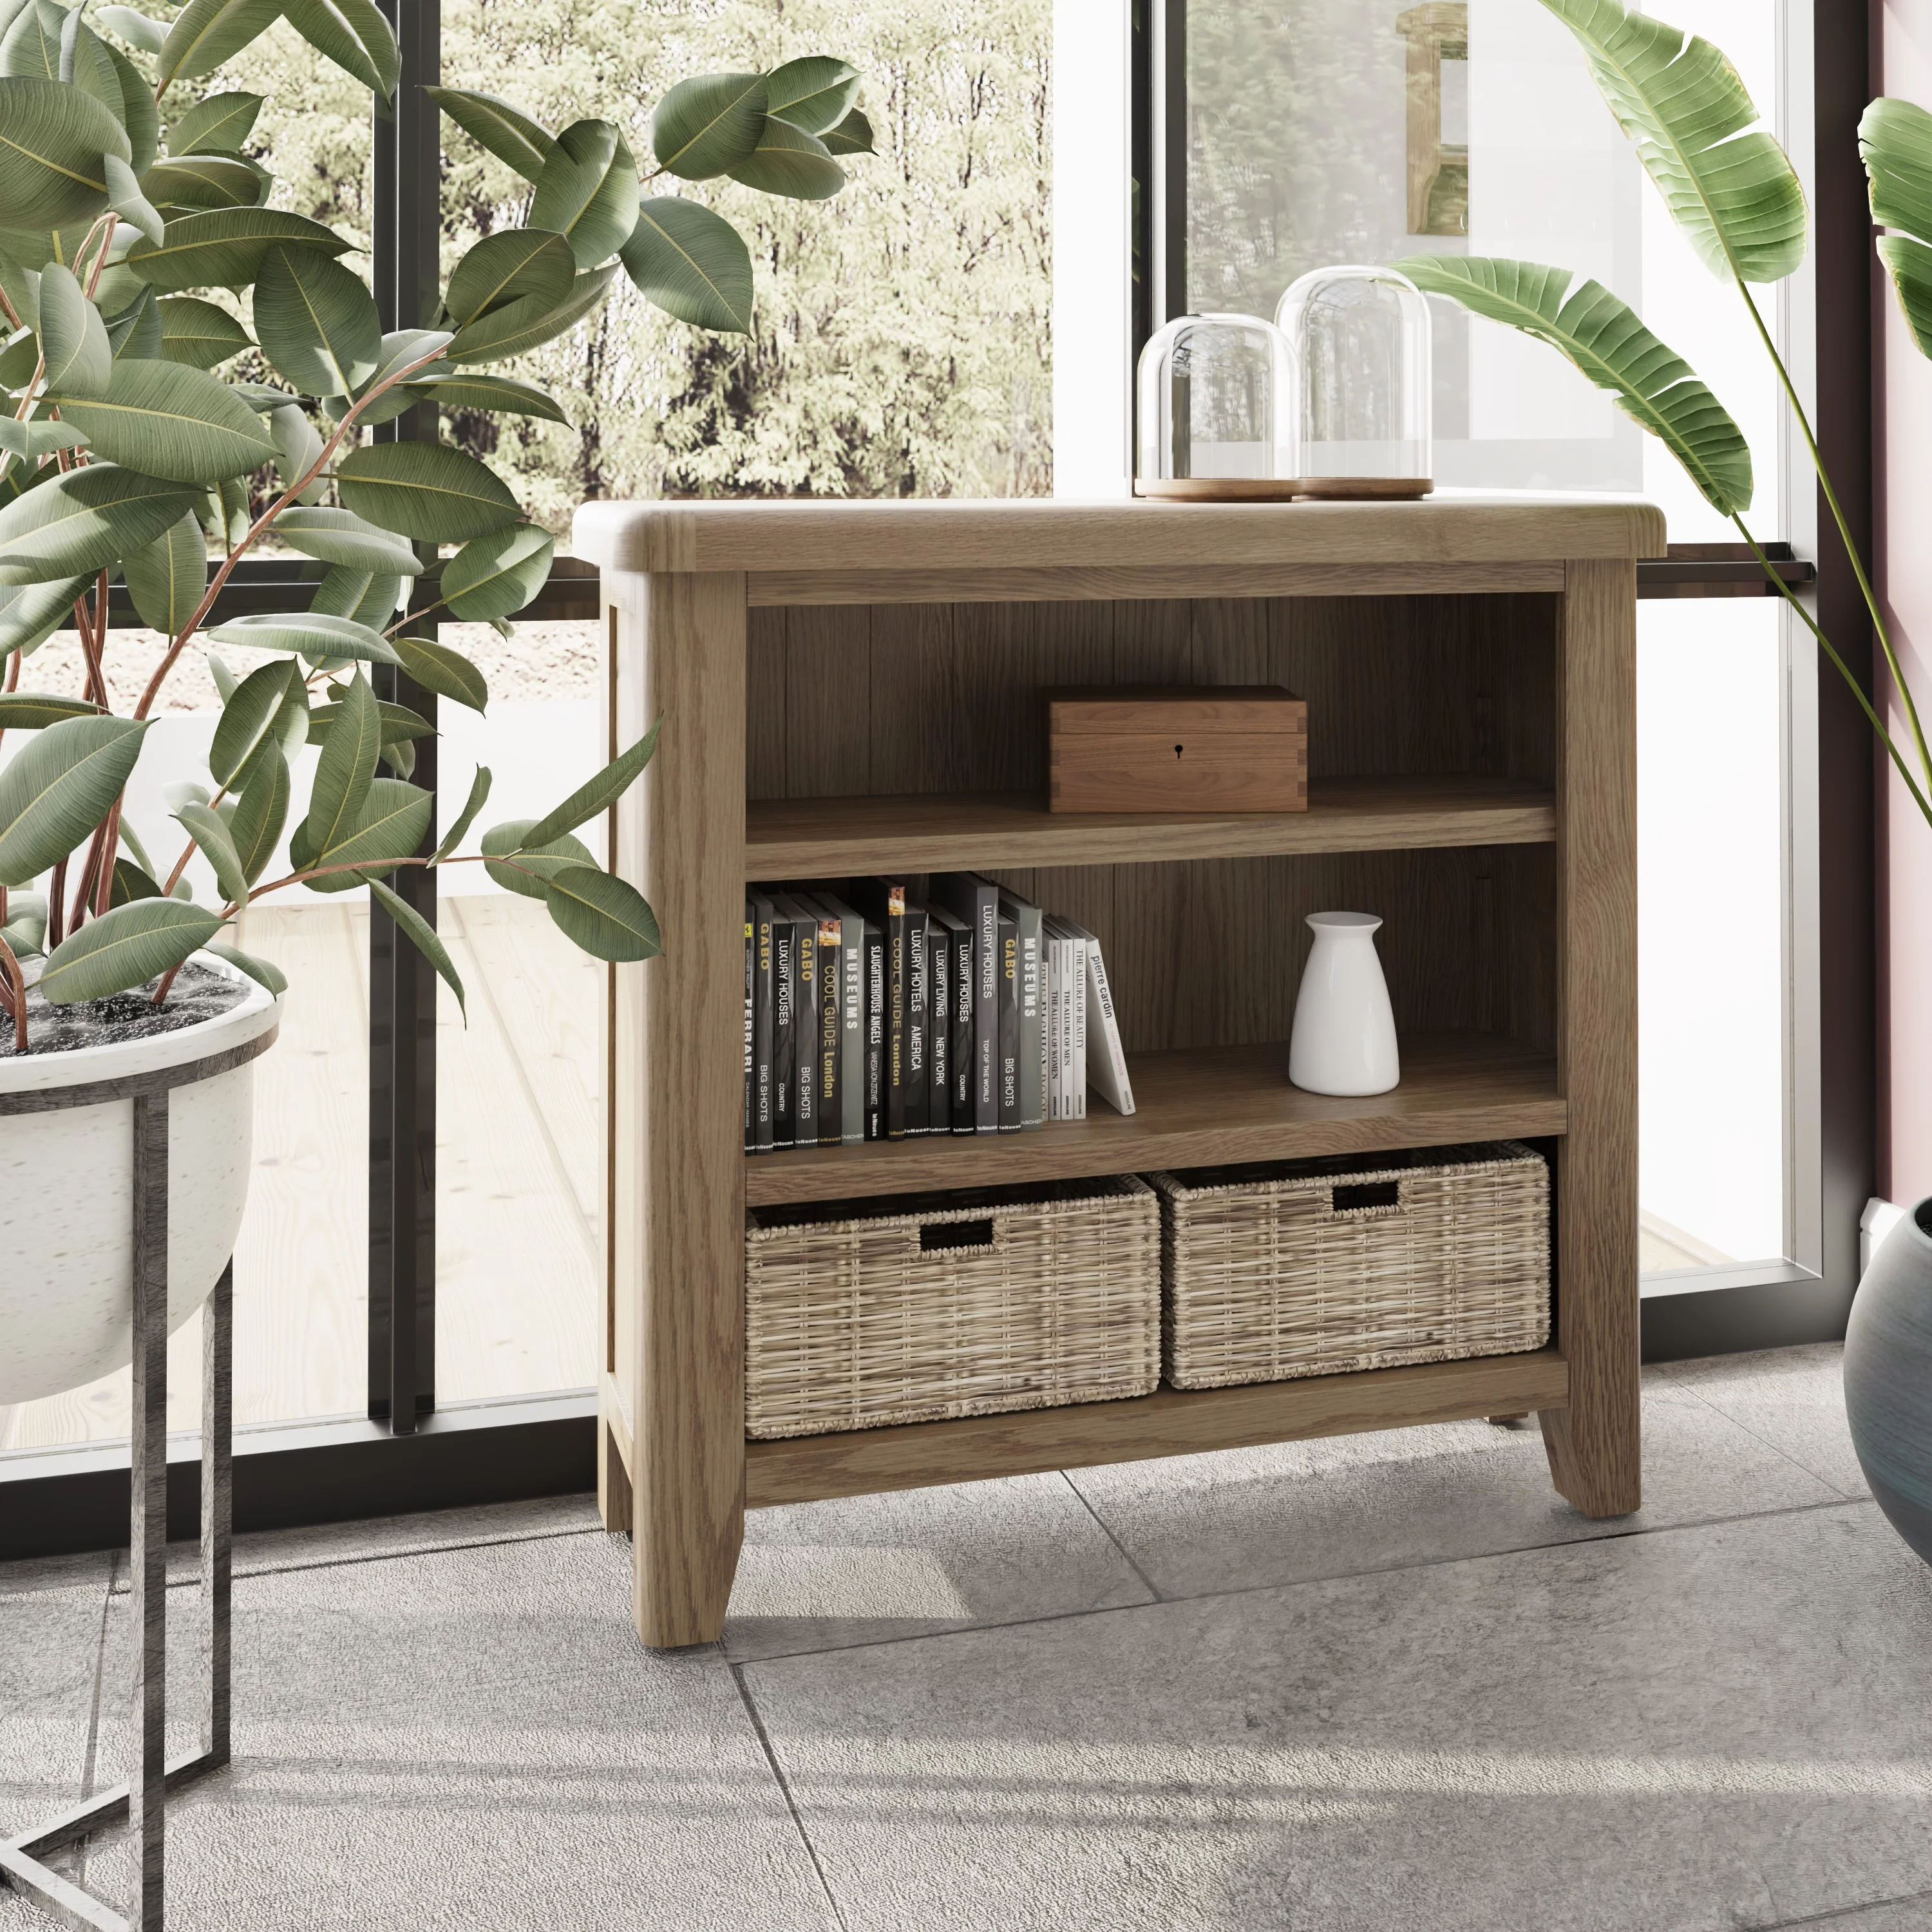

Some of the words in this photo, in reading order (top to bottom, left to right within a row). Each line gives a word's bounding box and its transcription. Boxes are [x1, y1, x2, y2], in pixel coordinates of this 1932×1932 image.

[761, 923, 770, 970] GABO
[983, 905, 992, 949] LUXURY
[779, 940, 788, 979] LUXURY
[801, 938, 813, 981] GABO
[911, 929, 922, 969] LUXURY
[936, 950, 945, 985] LUXURY
[960, 944, 969, 981] LUXURY
[1005, 938, 1016, 979] GABO
[824, 965, 835, 1002] COOL
[846, 948, 858, 1029] MUSEUMS
[871, 945, 881, 1014] SLAUGHTERHOUSE
[911, 972, 922, 1012] HOTELS
[983, 952, 992, 998] HOUSES
[1024, 938, 1036, 1017] MUSEUMS
[1090, 955, 1104, 985] pierre
[1099, 987, 1113, 1018] cardin
[779, 983, 788, 1025] HOUSES
[936, 988, 945, 1017] LIVING
[960, 983, 969, 1023] HOUSES
[1076, 1002, 1083, 1014] OF
[824, 1007, 835, 1047] GUIDE
[871, 1016, 881, 1045] ANGELS
[1052, 1038, 1058, 1048] OF
[1064, 1037, 1070, 1046] OF
[911, 1025, 922, 1071] AMERICA
[936, 1037, 945, 1057] NEW
[983, 1054, 989, 1064] OF
[1005, 1058, 1014, 1074] BIG
[801, 1066, 811, 1083] BIG
[824, 1052, 835, 1098] London
[936, 1059, 945, 1085] YORK
[1005, 1075, 1014, 1106] SHOTS
[801, 1086, 811, 1119] SHOTS
